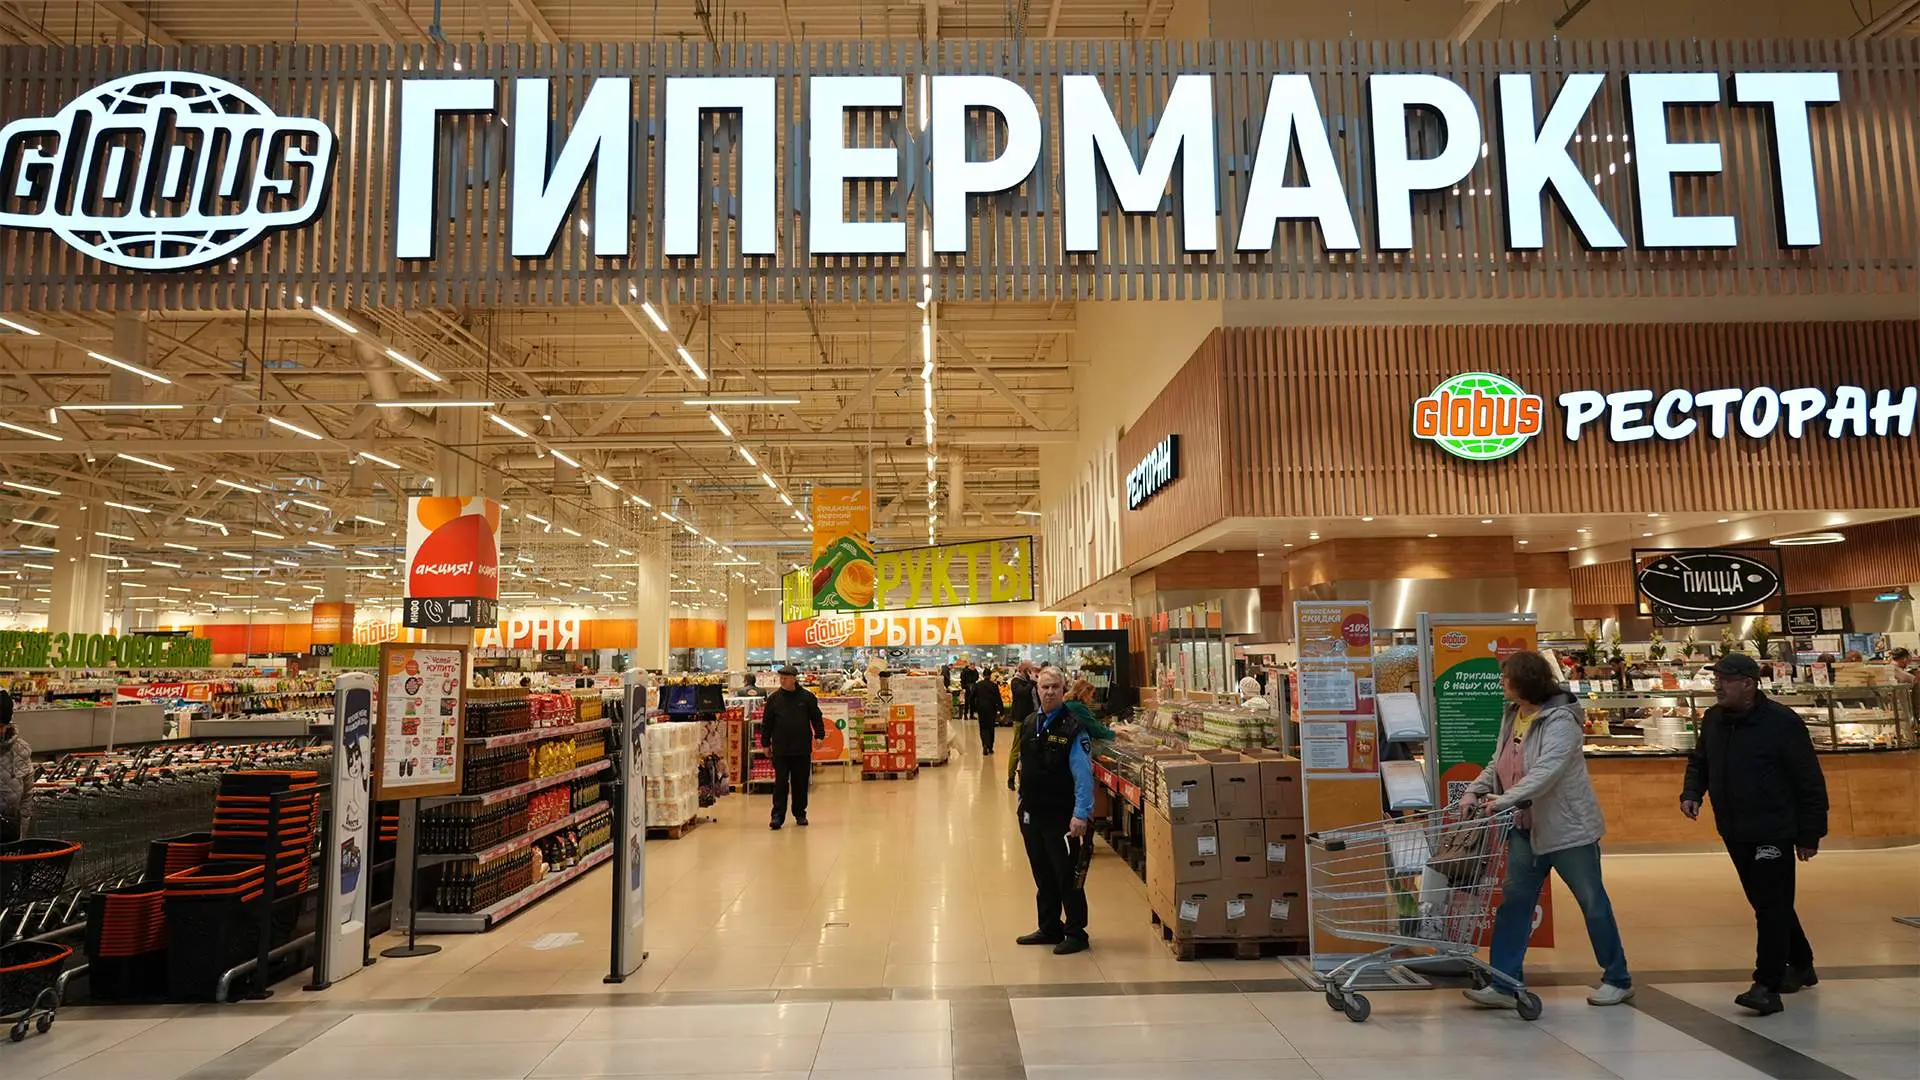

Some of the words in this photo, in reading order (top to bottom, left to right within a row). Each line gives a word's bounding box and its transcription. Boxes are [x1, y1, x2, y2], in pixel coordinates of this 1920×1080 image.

[397, 72, 1840, 258] ГИПЕРМАРКЕТ
[1415, 390, 1541, 438] Globus
[1559, 386, 1918, 442] РЕСТОРАН
[1126, 434, 1171, 511] РЕСТОРАН
[415, 561, 474, 576] акция!
[877, 538, 1031, 609] РУКТЫ
[1683, 570, 1744, 595] ПИЦЦА
[410, 600, 420, 623] ИНФО
[1301, 615, 1341, 623] СКИДКА
[864, 613, 966, 647] РЫБА
[1344, 623, 1369, 632] -10%
[51, 632, 167, 668] ЗДОРОВОЕ
[426, 664, 456, 672] КУПИТЬ
[136, 684, 185, 698] акция!
[1443, 681, 1451, 690] в
[1453, 682, 1481, 690] нашу
